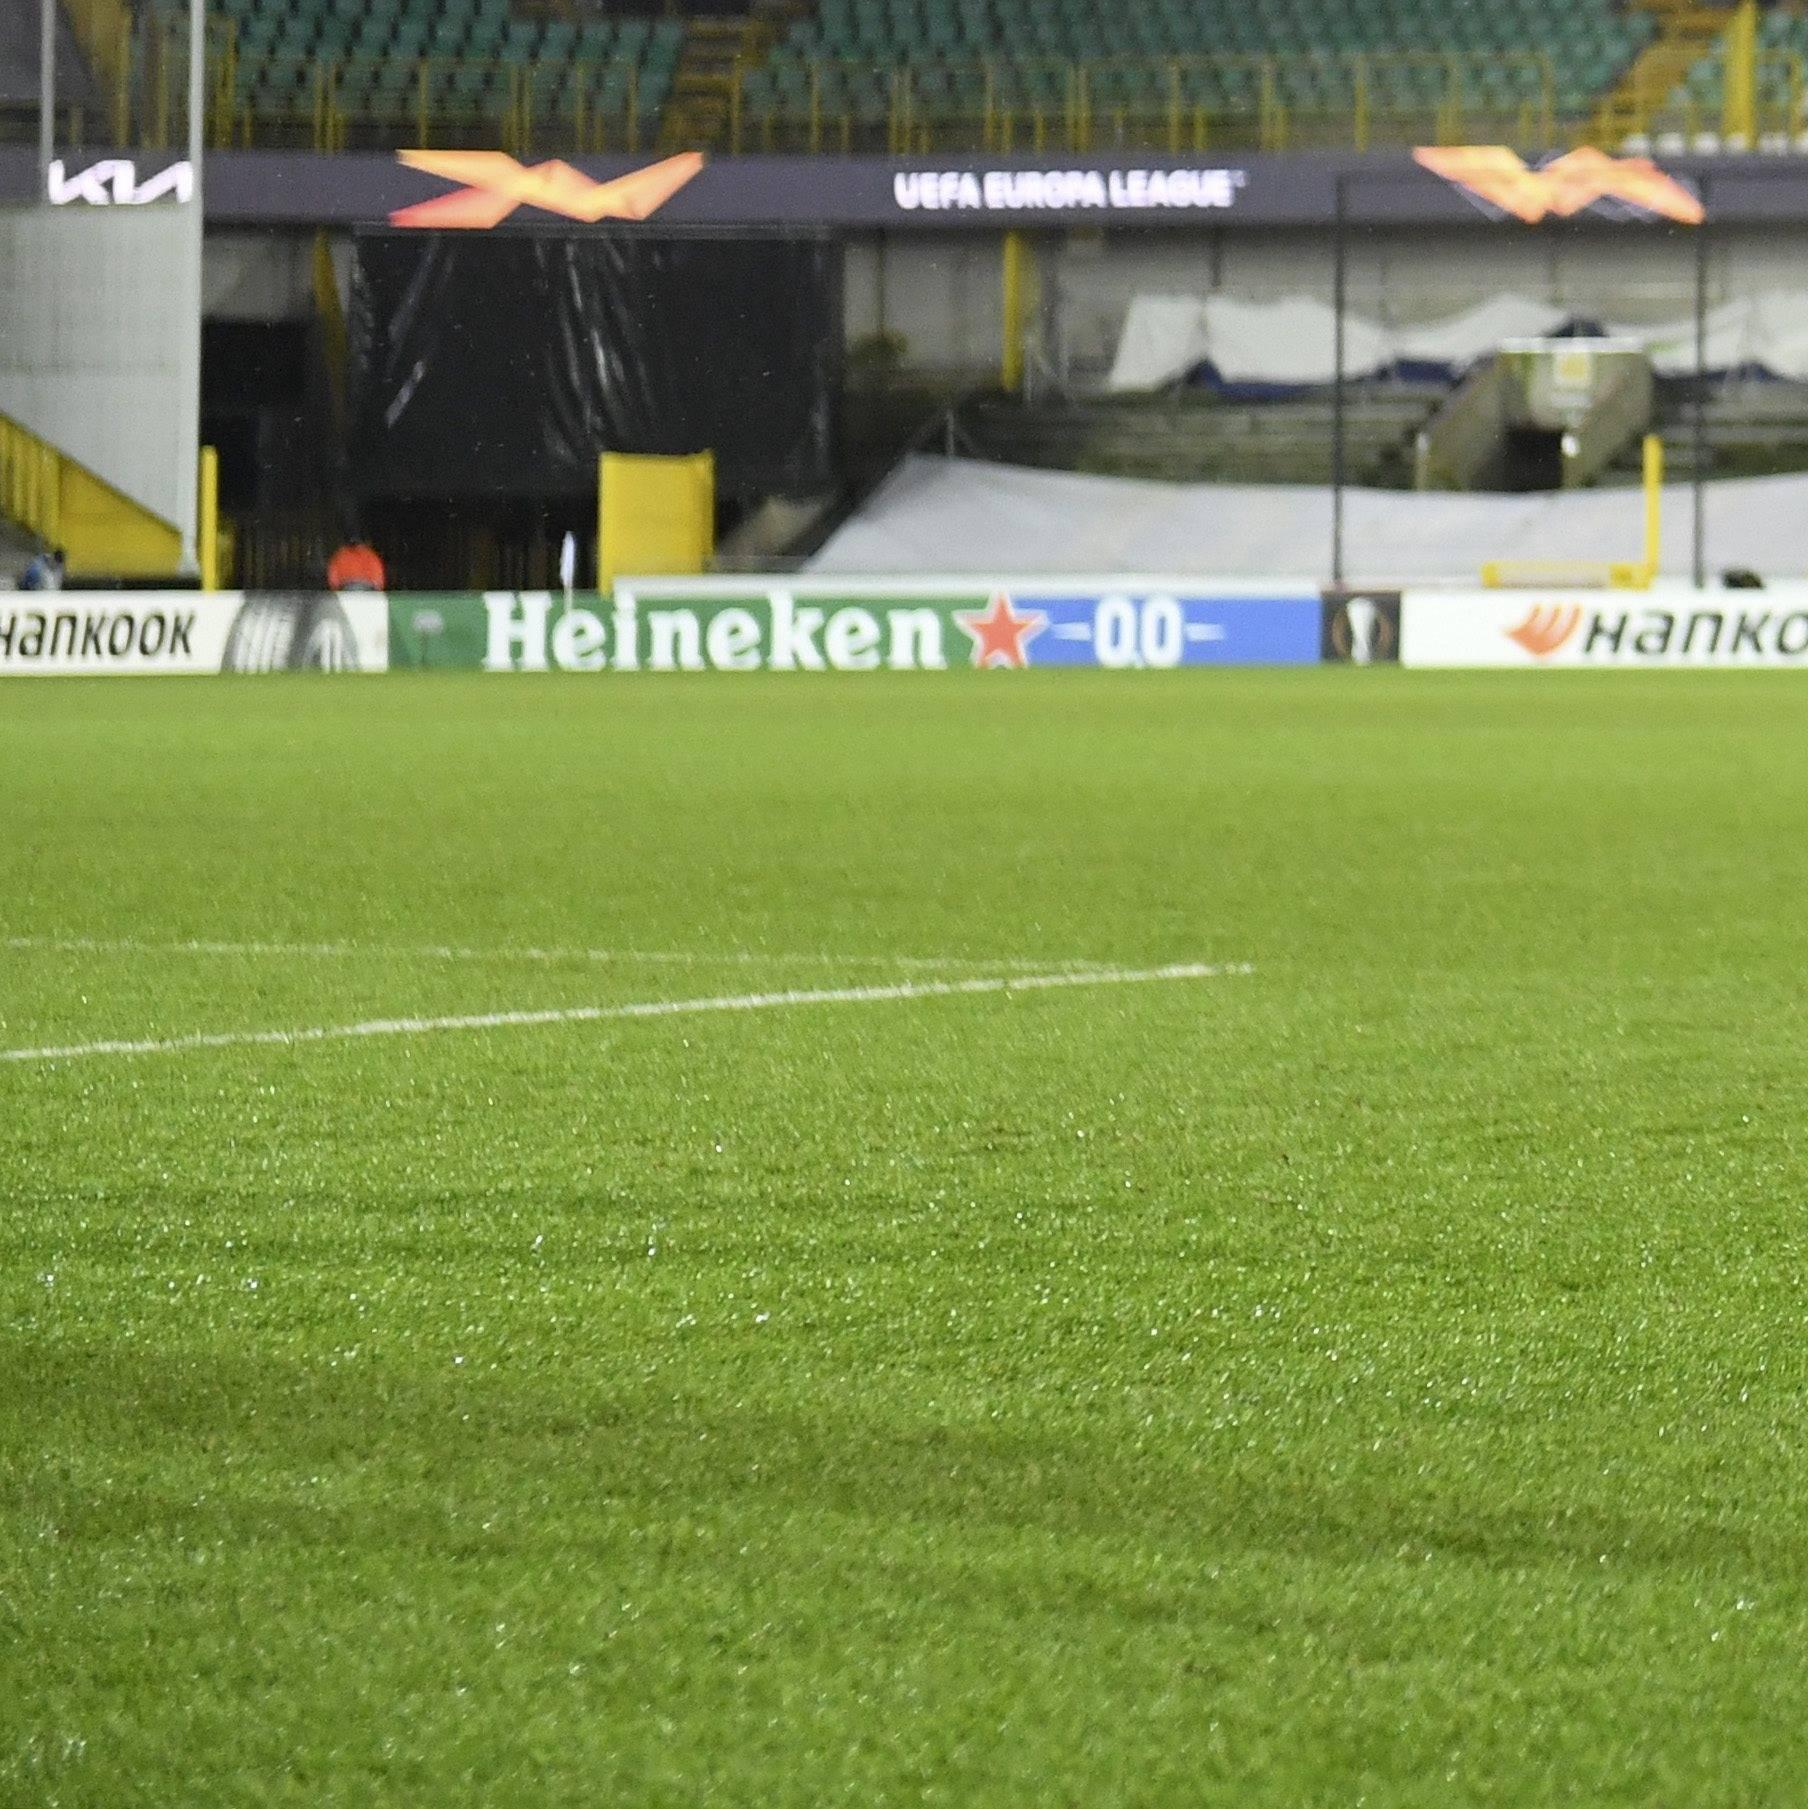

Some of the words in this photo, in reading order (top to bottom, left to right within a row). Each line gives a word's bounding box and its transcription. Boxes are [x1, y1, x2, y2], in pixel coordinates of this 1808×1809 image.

[893, 171, 982, 210] UEFA
[983, 170, 1107, 209] EUROPA
[1109, 169, 1235, 208] LEAGUE
[482, 590, 948, 672] Heineken
